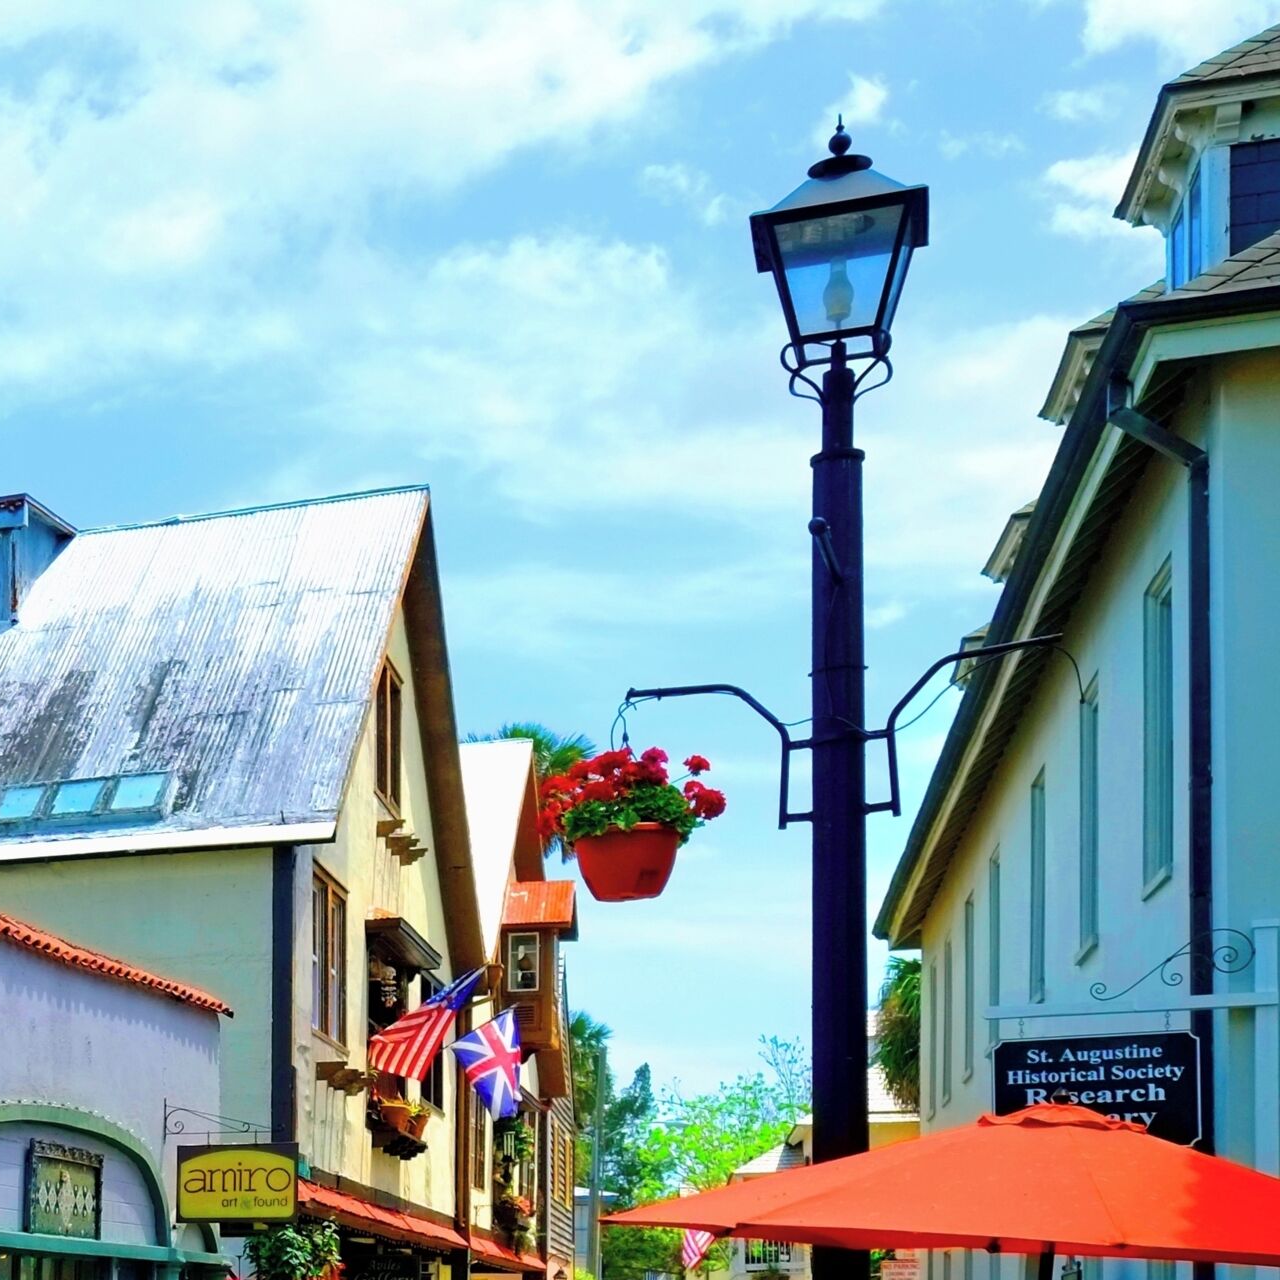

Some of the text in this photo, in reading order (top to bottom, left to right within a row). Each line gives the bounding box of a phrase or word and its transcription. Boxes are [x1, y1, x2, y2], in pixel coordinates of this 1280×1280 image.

[1026, 1043, 1164, 1065] St. Augustine
[1006, 1063, 1185, 1085] Historical Society
[1025, 1083, 1167, 1107] Rsearch
[183, 1161, 292, 1194] amiro
[221, 1197, 238, 1208] art
[253, 1195, 288, 1208] found
